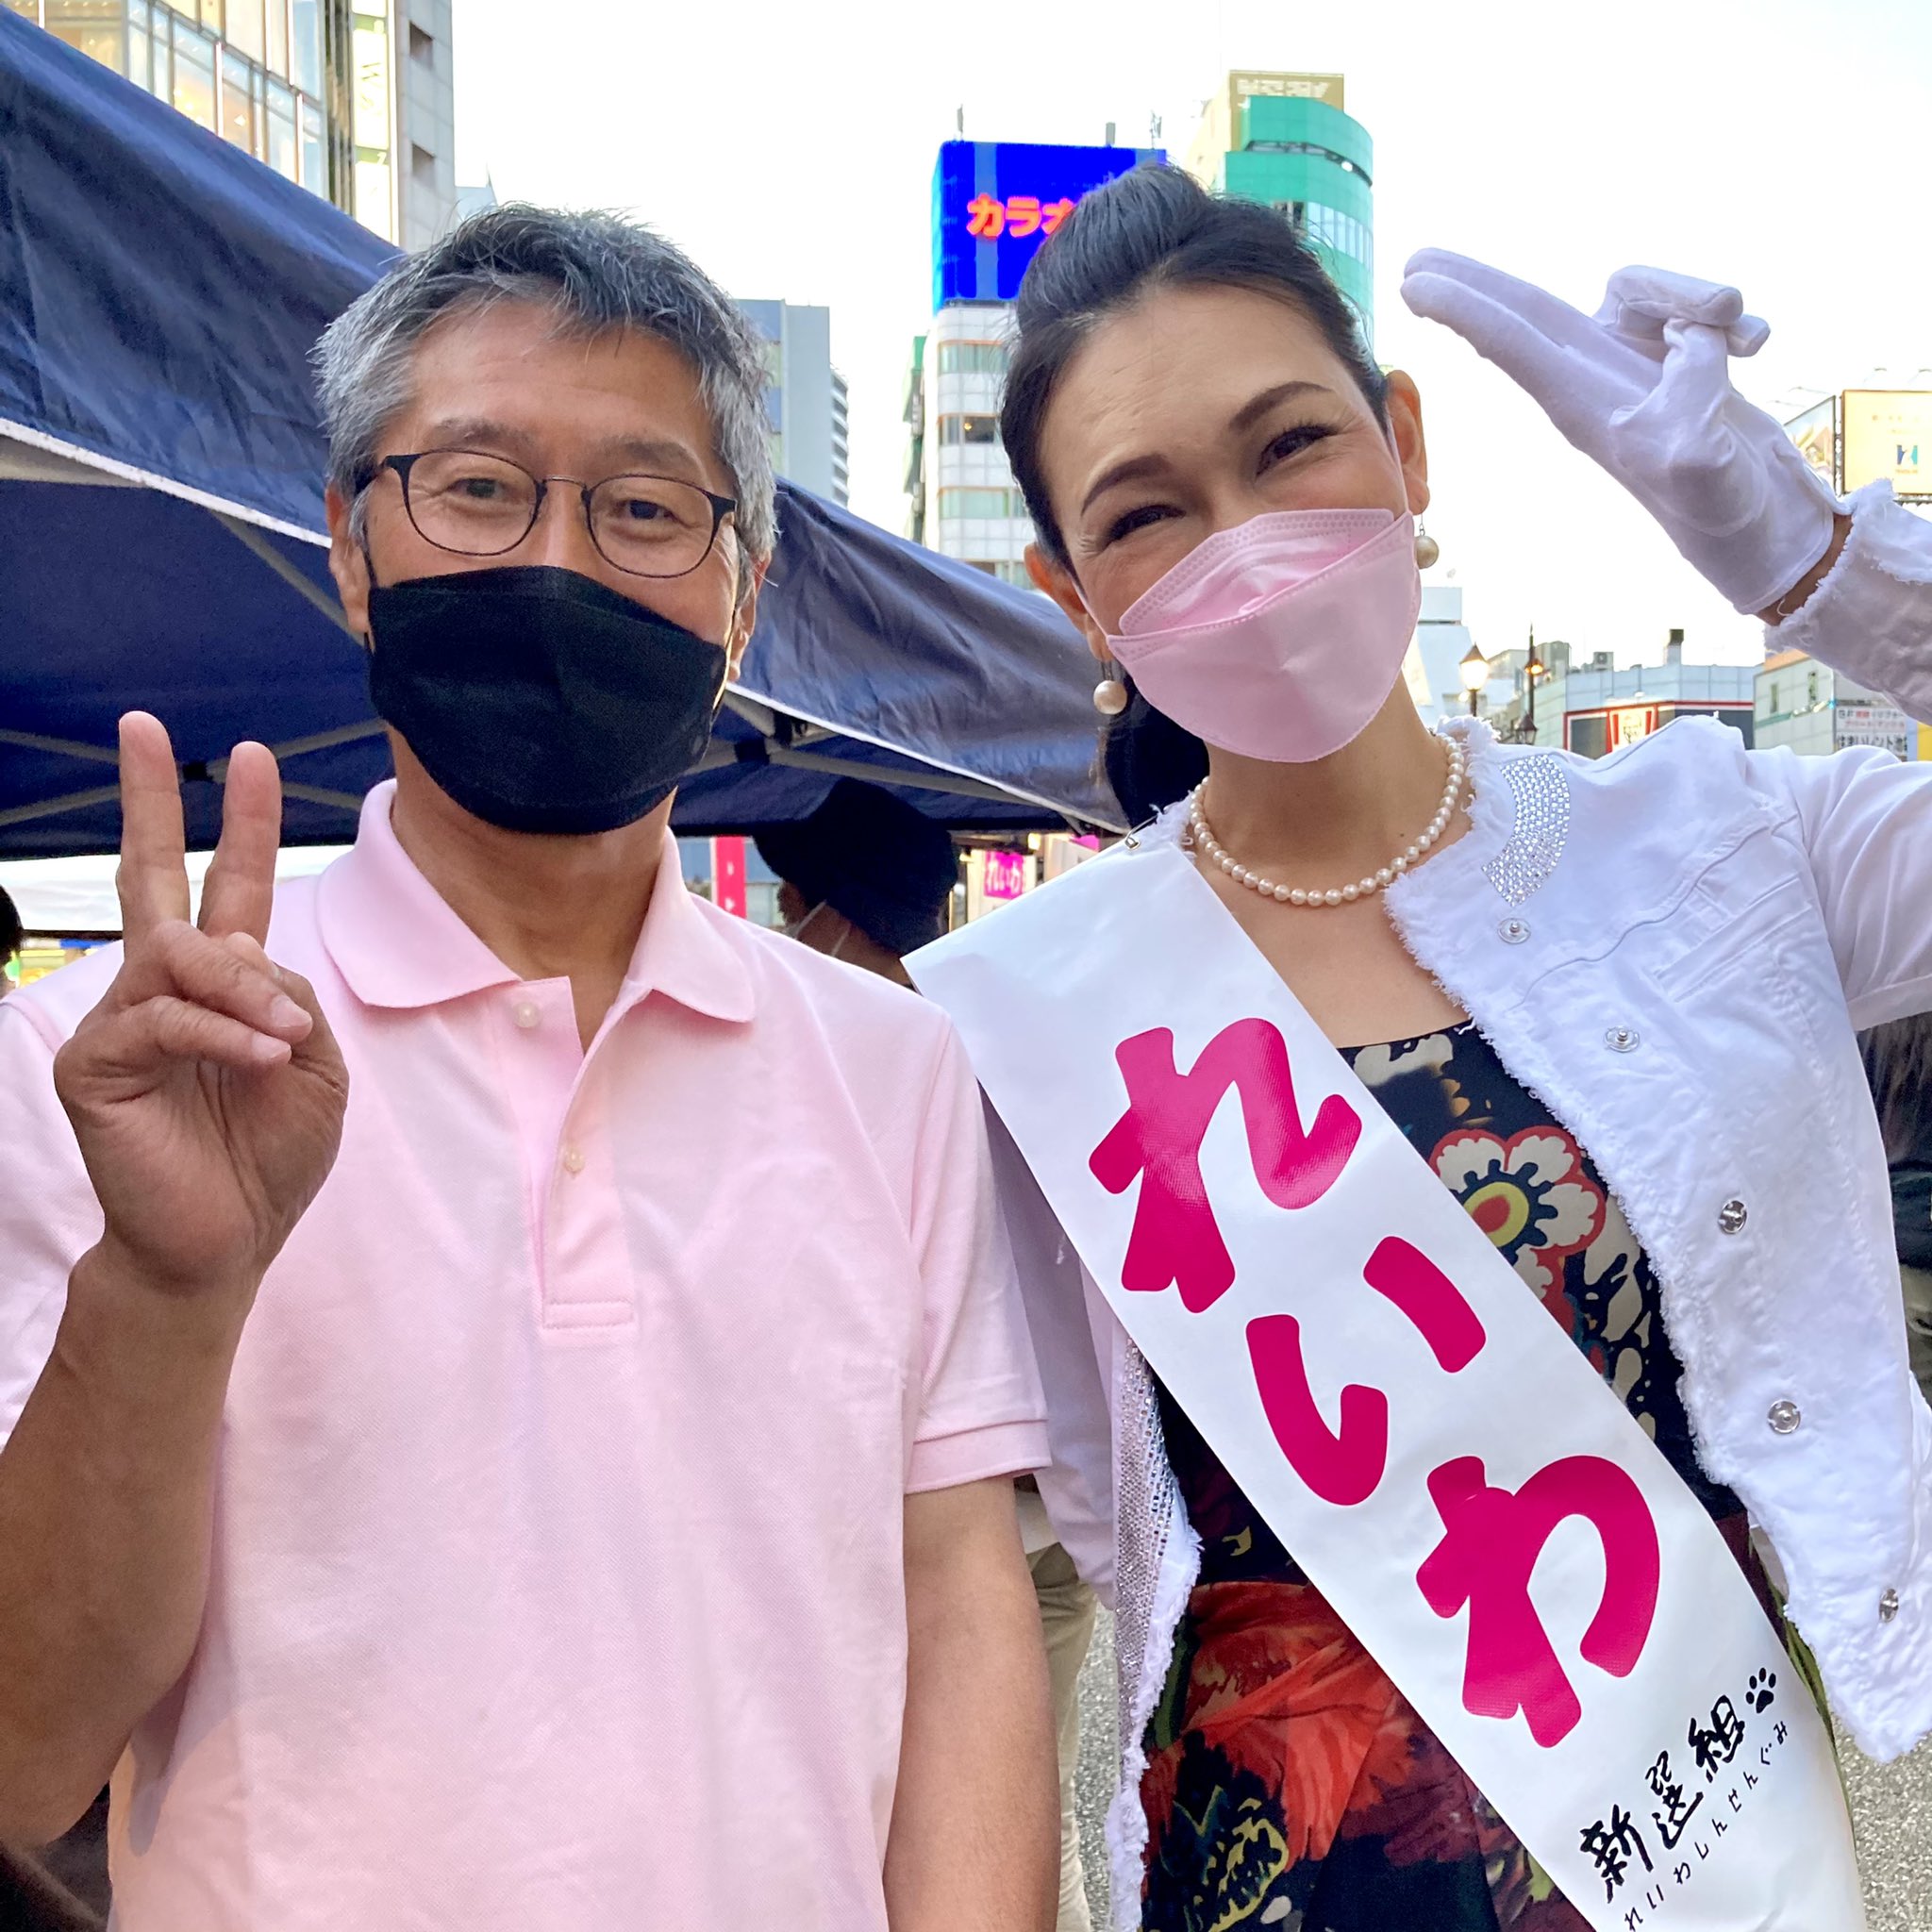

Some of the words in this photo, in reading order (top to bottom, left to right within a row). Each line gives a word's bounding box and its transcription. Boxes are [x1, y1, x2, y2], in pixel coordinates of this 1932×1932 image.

[1089, 1018, 1660, 1748] れいわ
[1579, 1694, 1745, 1904] 新選組
[1624, 1721, 1789, 1932] れいわしんせんぐみ
